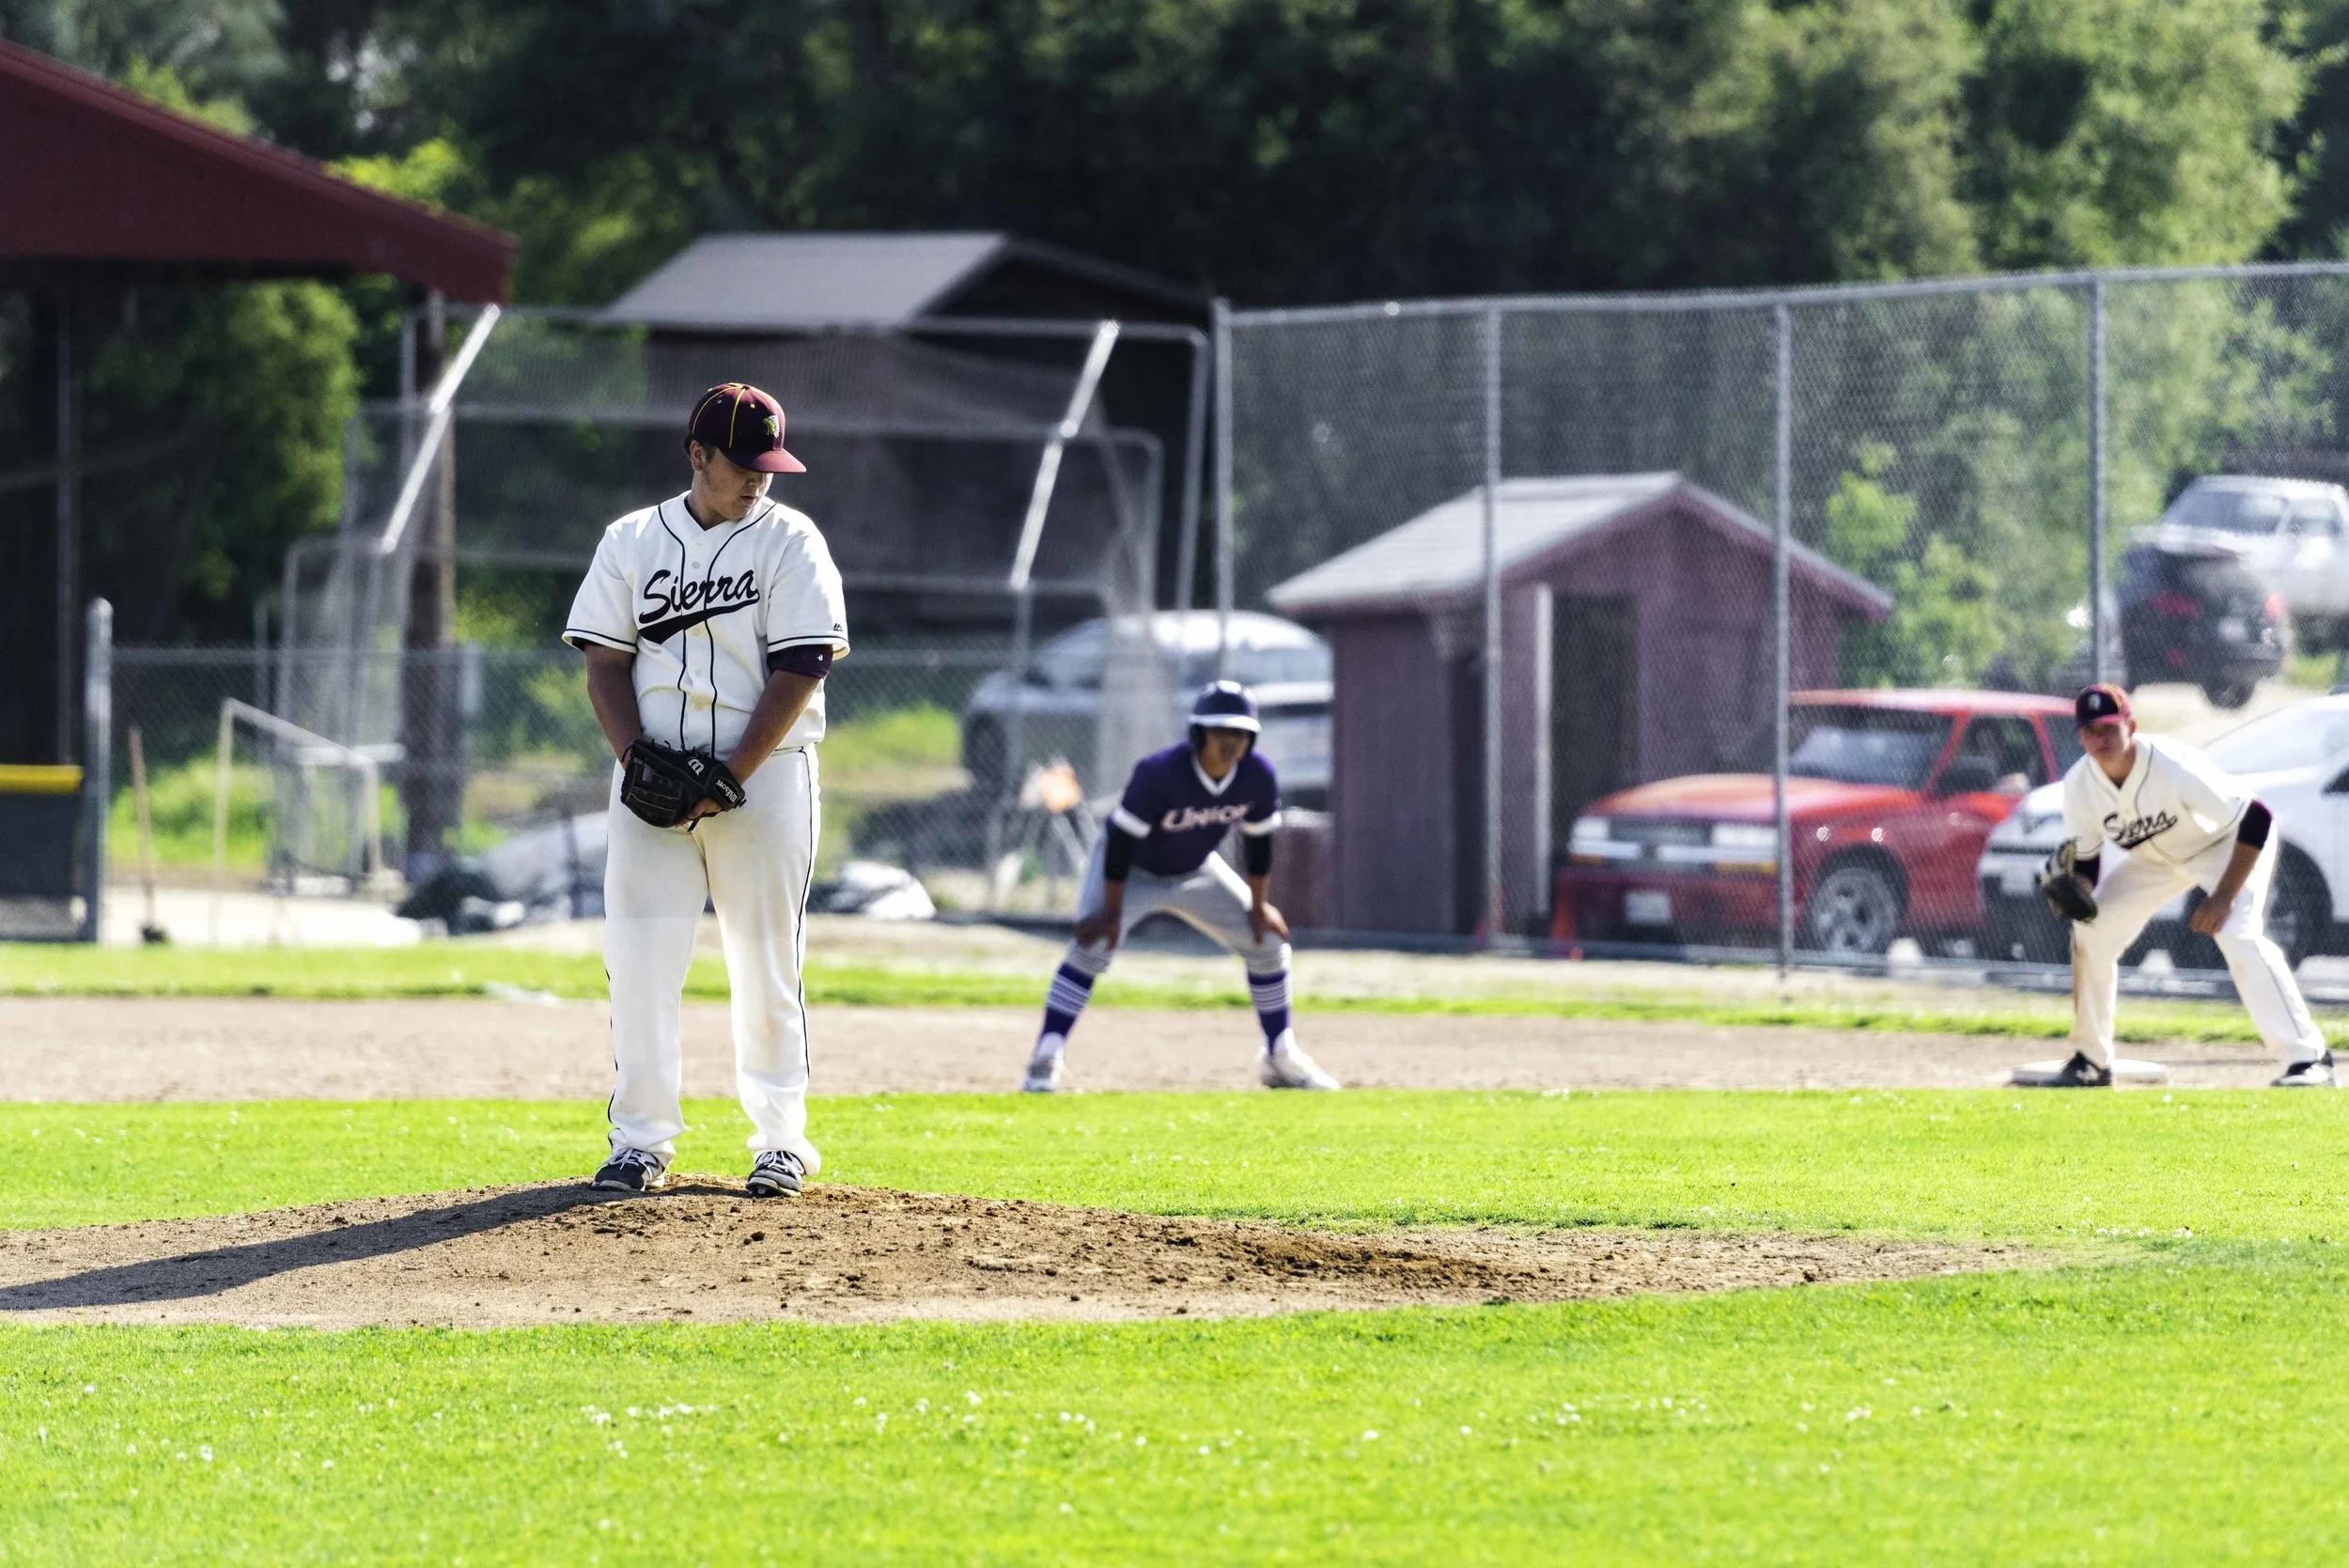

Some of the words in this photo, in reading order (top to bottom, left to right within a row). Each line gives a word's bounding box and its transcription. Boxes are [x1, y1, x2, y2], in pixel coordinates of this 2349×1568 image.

[639, 569, 759, 624] Sierra
[715, 779, 739, 803] Wilson
[2103, 810, 2178, 844] Sierra
